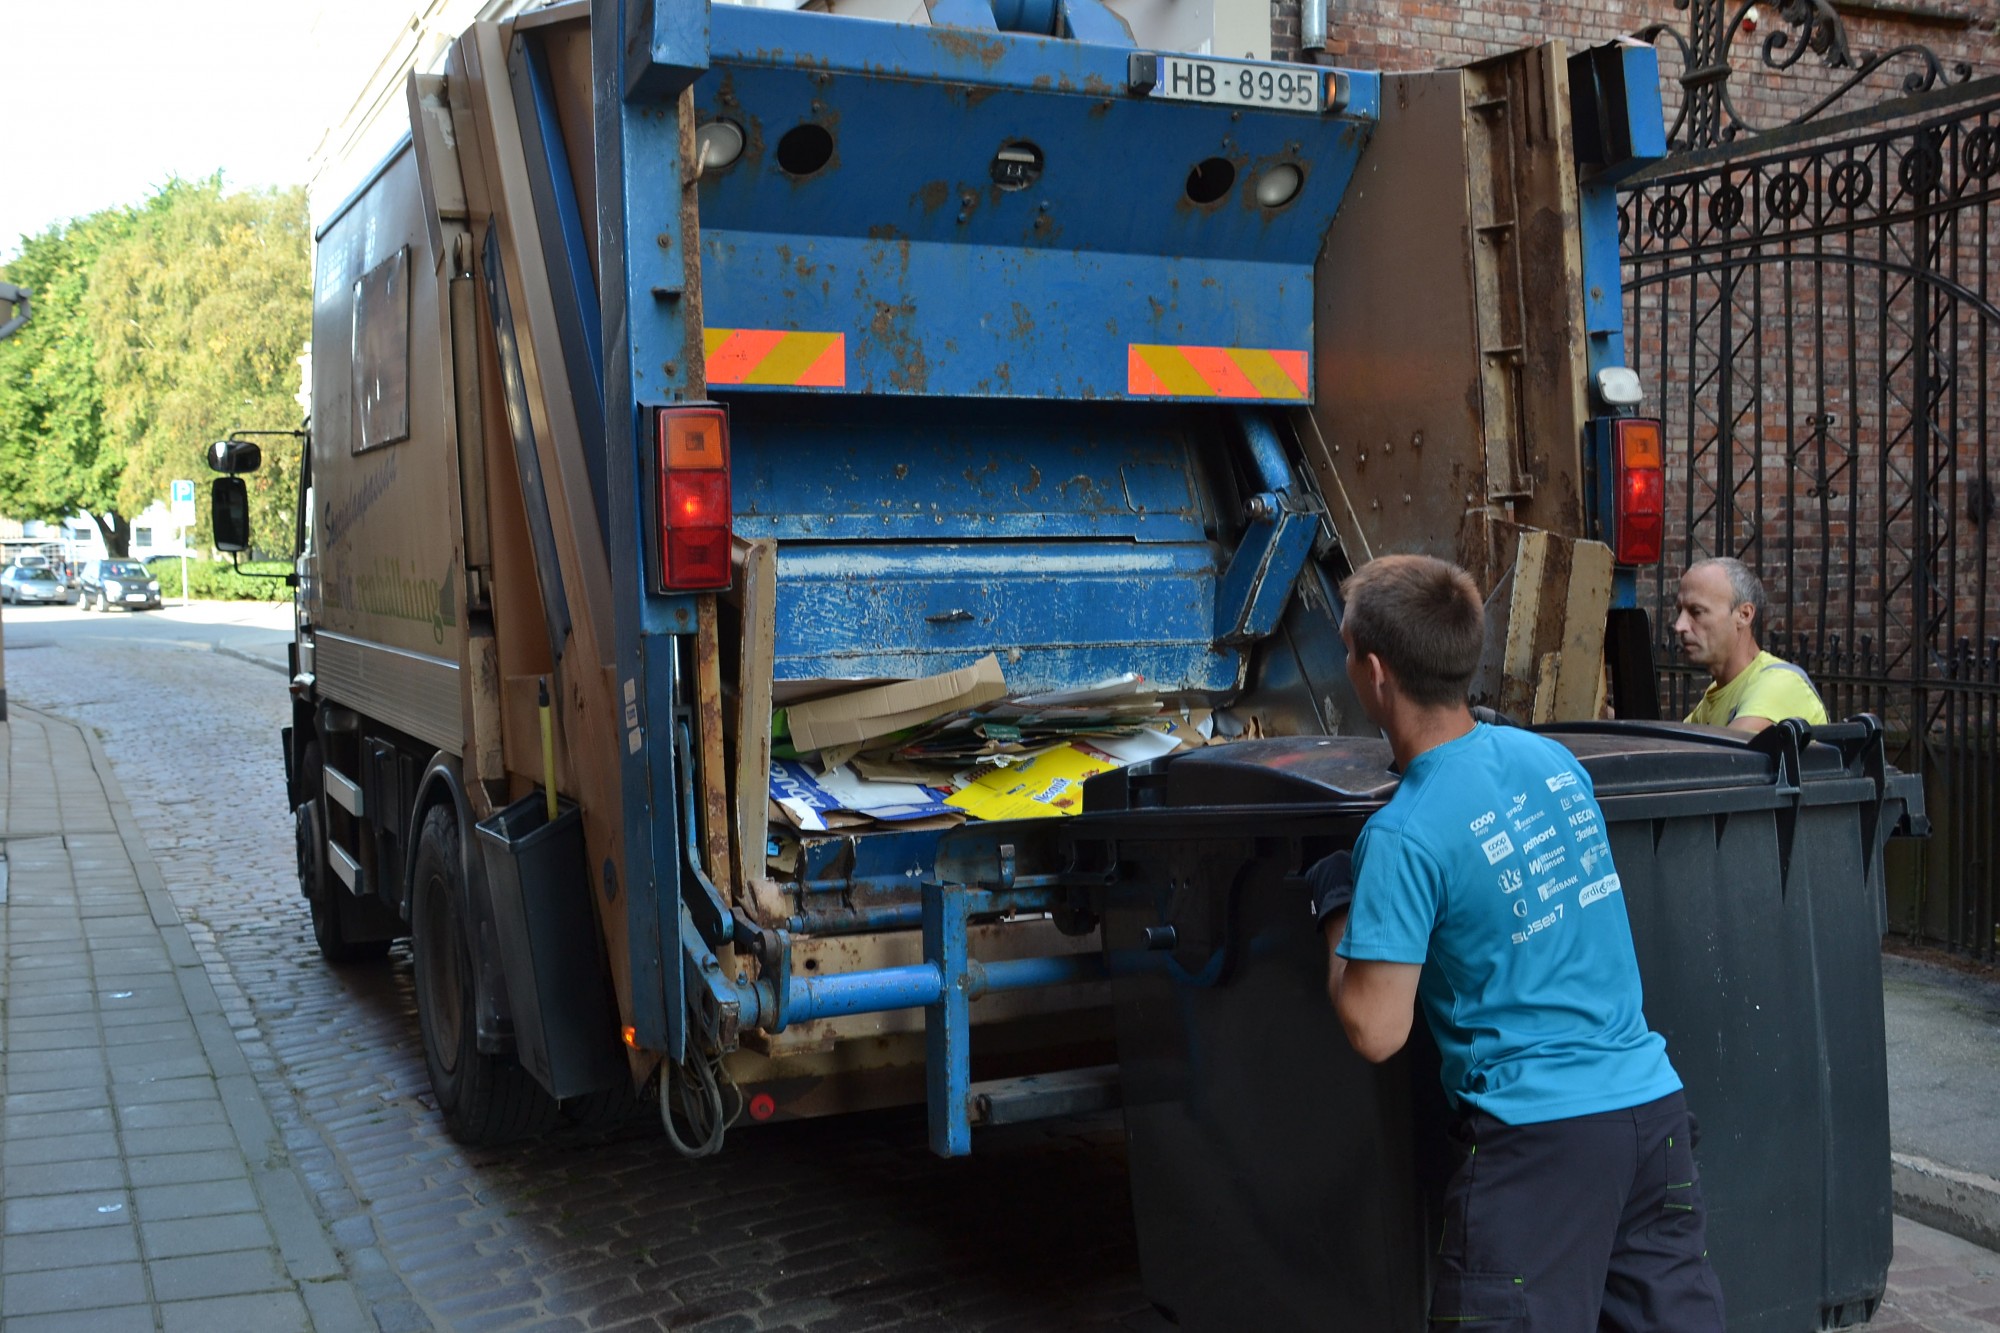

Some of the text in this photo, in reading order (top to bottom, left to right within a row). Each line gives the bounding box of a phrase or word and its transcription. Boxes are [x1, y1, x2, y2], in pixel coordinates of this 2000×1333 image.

[177, 482, 190, 501] P
[1031, 778, 1072, 804] Nesquik
[1470, 811, 1495, 831] coop
